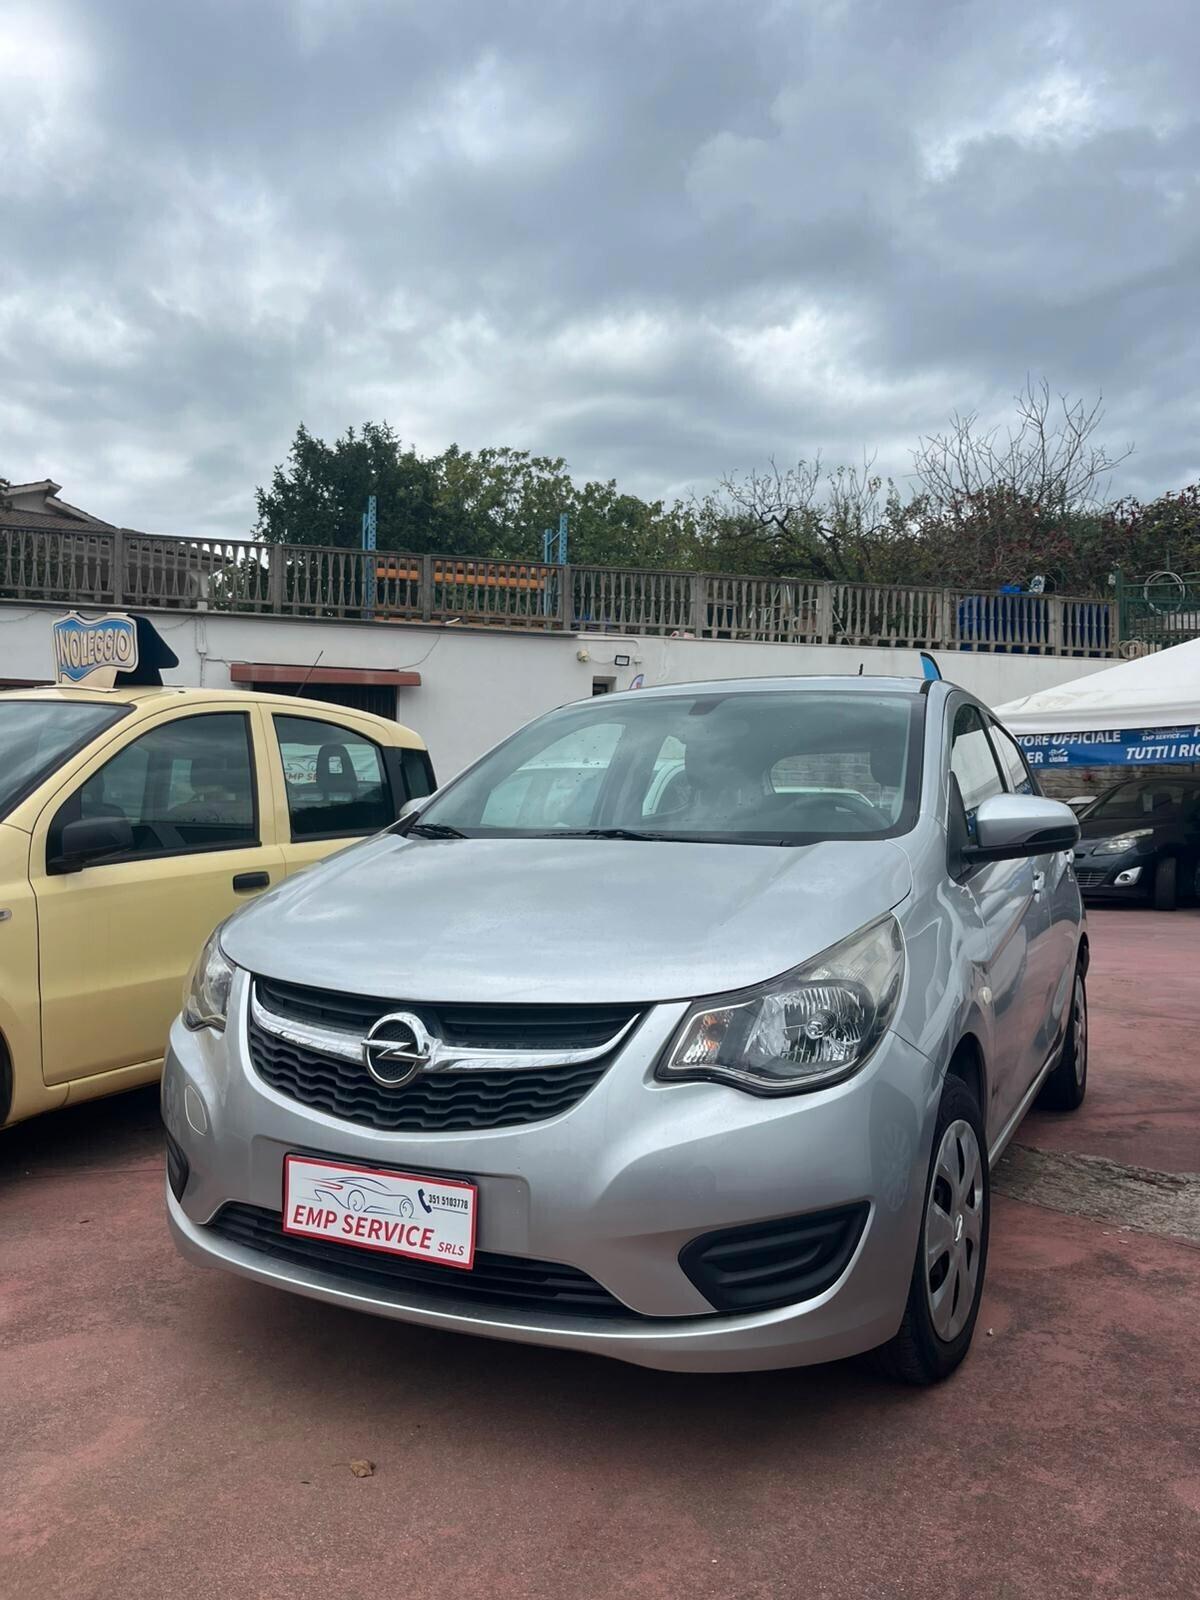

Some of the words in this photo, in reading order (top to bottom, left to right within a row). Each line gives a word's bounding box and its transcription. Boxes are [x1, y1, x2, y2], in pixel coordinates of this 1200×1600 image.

[59, 628, 132, 669] NOLEGGIO
[1052, 731, 1121, 745] UFFICIALE
[1126, 745, 1169, 760] TUTTI
[1170, 744, 1177, 758] I
[285, 772, 304, 781] MP
[428, 1194, 440, 1205] 351
[292, 1204, 338, 1230] EMP
[341, 1213, 435, 1250] SERVICE
[437, 1241, 465, 1256] SRLS
